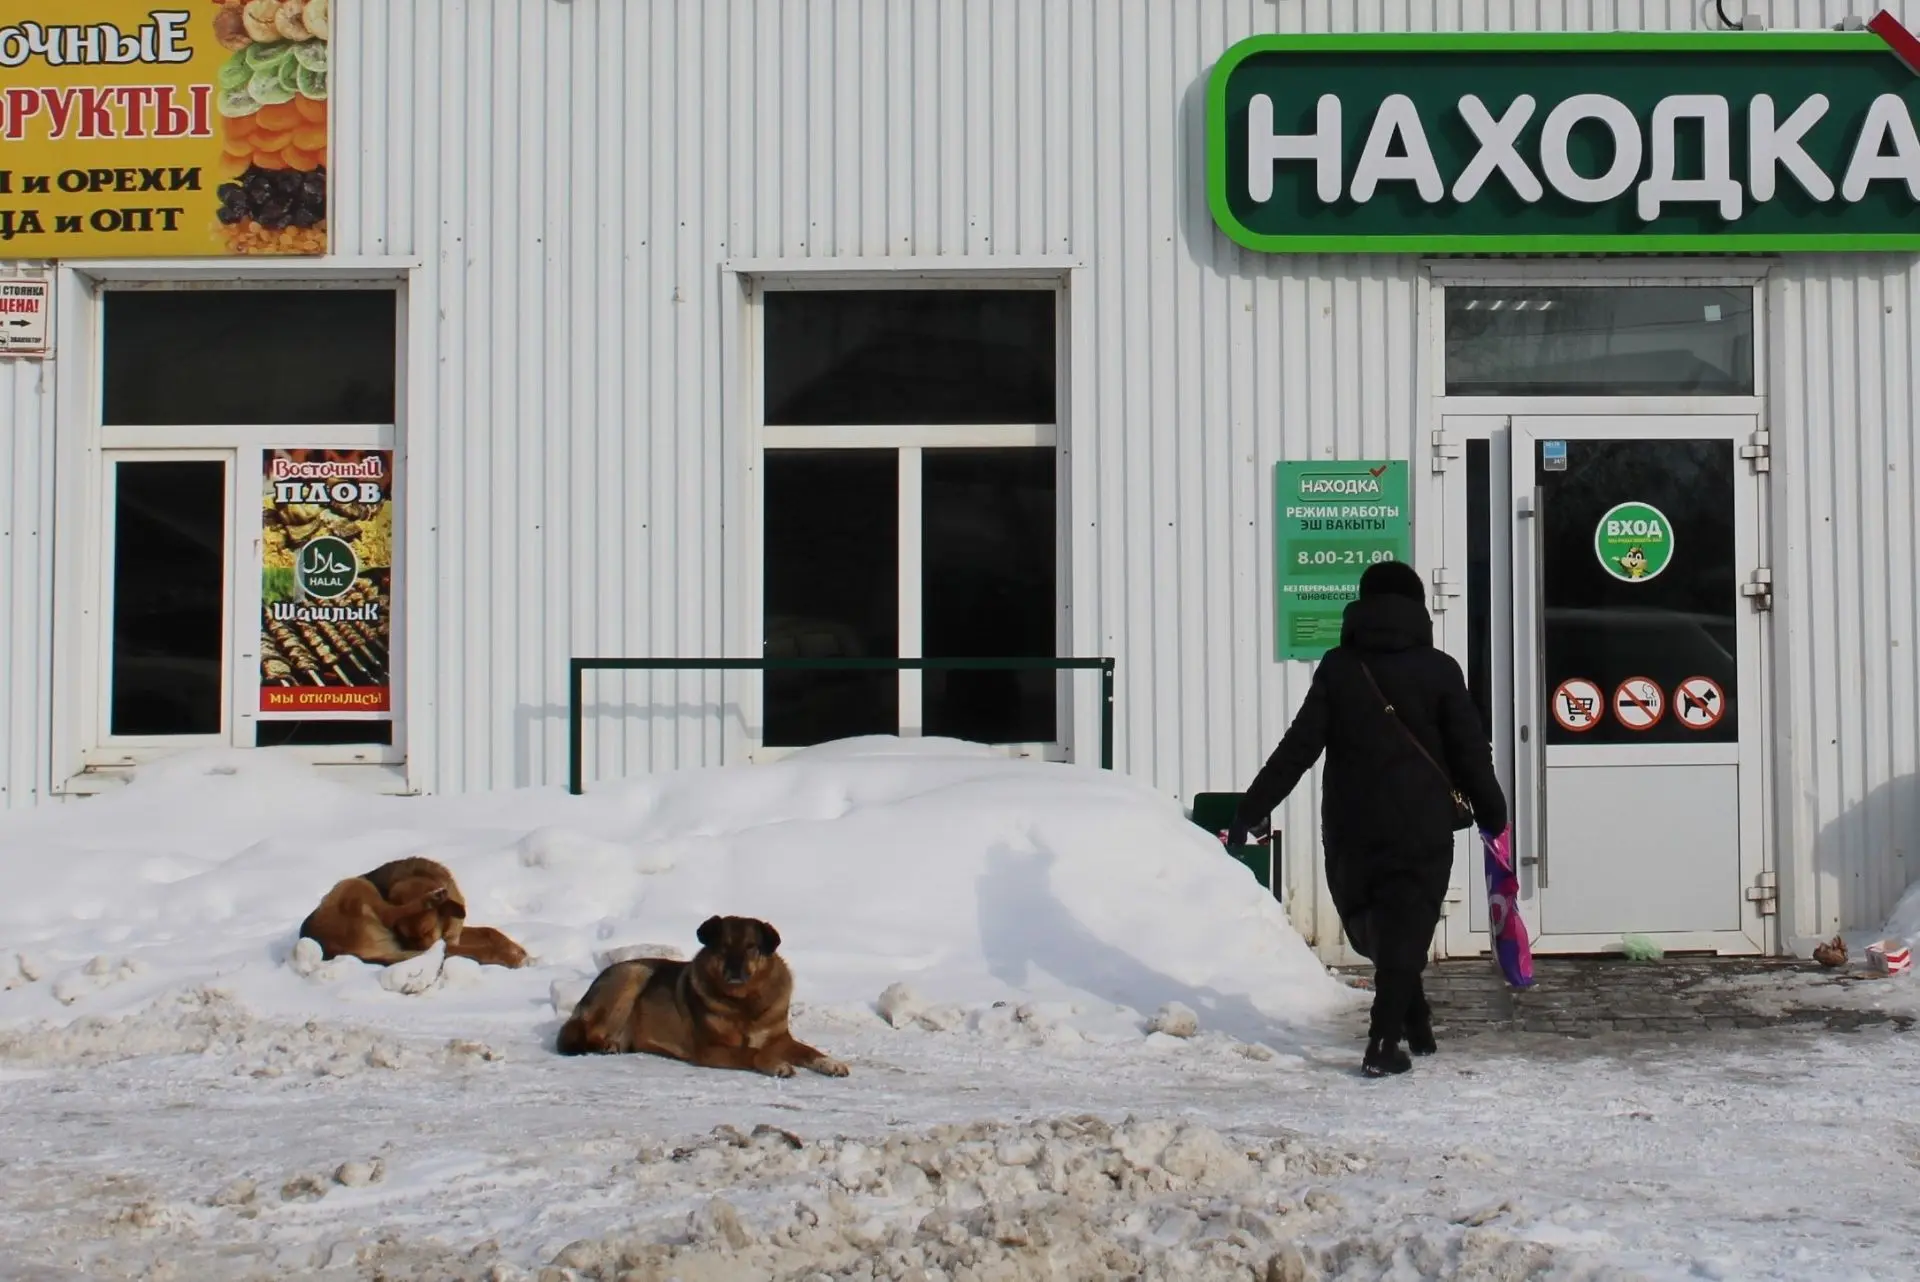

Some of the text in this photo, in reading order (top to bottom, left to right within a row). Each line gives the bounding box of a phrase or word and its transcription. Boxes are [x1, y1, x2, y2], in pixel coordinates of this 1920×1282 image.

[0, 85, 213, 140] РУКТЫ
[1248, 93, 1920, 221] НАХОДКА
[57, 167, 202, 193] ОРЕХИ
[90, 207, 184, 233] ОПТ
[3, 285, 44, 296] СТОЯНКА
[274, 456, 382, 479] Восточный
[275, 482, 381, 503] ПЛОВ
[1301, 479, 1379, 494] НАХОДКА
[1286, 506, 1400, 518] РЕЖИМ РАБОТЫ
[1300, 520, 1386, 531] ЭШ ВАКЫТЫ
[1607, 520, 1663, 539] ВХОД
[1297, 550, 1394, 565] 8.00-21.00
[309, 577, 344, 587] HALAL
[1283, 585, 1298, 593] БЕЗ
